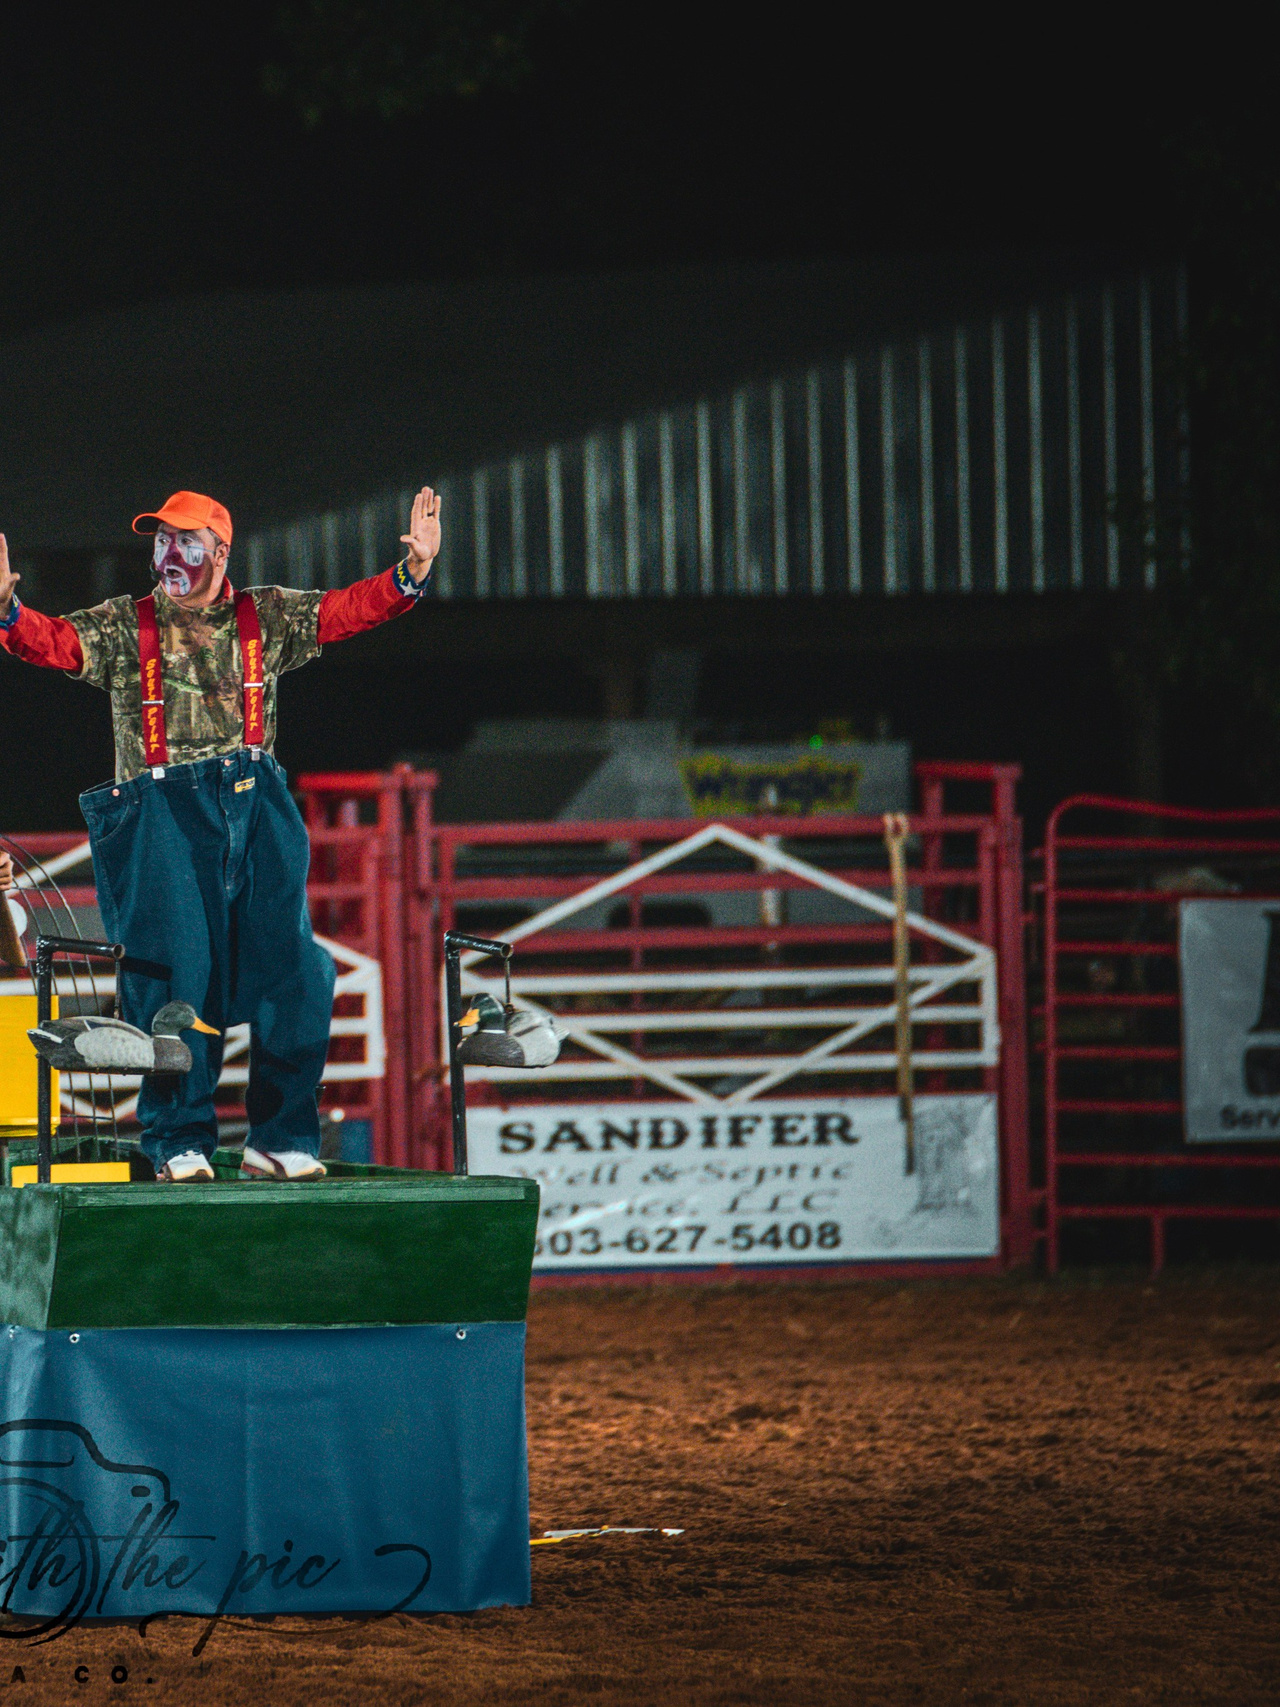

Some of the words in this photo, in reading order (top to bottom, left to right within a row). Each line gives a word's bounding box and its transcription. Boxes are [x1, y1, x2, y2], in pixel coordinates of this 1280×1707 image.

[147, 706, 160, 754] POINT
[249, 687, 259, 732] POINT
[498, 1112, 860, 1154] SANDIFER
[641, 1161, 692, 1186] &
[694, 1159, 854, 1188] Septic
[542, 1197, 699, 1218] erice,
[721, 1188, 840, 1215] LLC
